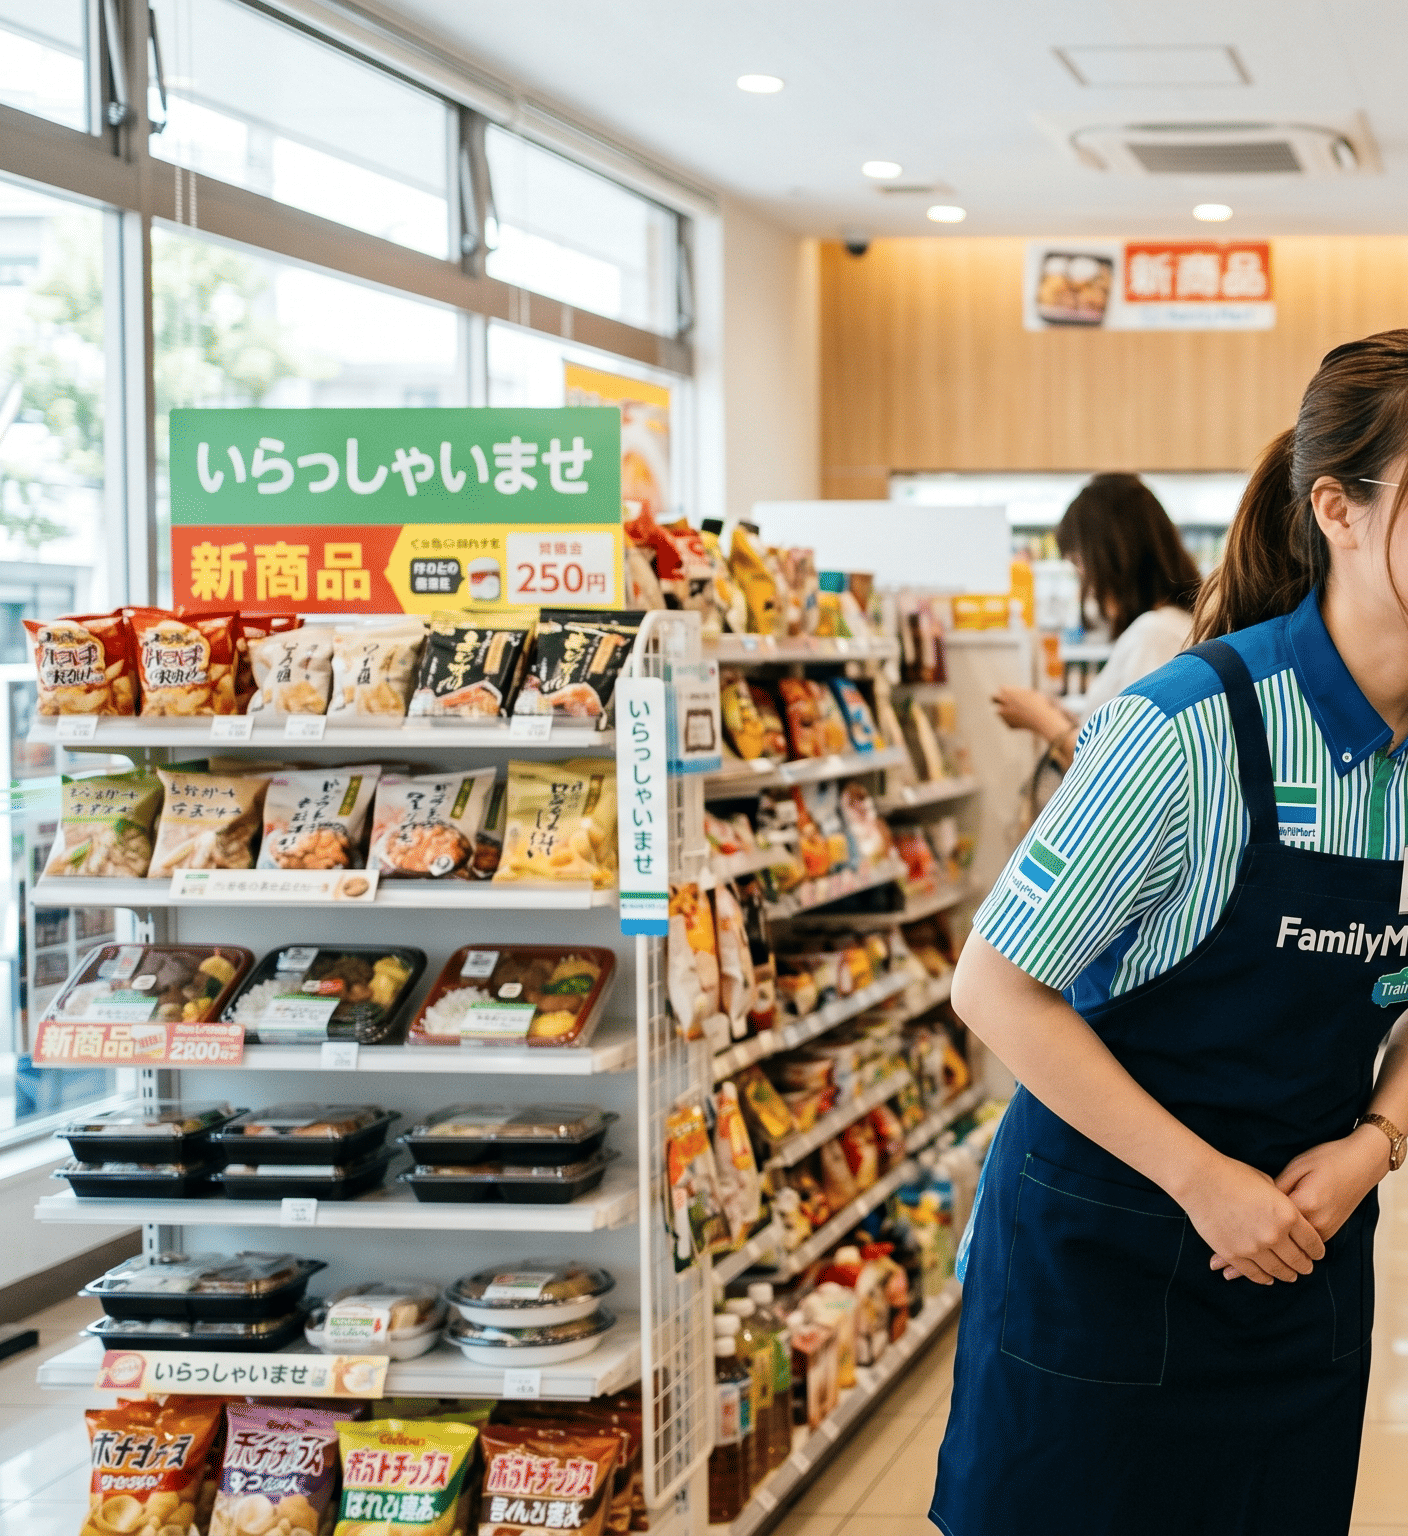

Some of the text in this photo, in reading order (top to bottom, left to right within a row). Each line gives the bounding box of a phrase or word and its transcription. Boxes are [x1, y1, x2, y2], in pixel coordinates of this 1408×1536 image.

[197, 435, 594, 497] いらっしゃいませ
[190, 541, 373, 603] 新商品
[516, 562, 606, 594] 250円
[629, 699, 654, 875] いらっしゃいませ
[41, 1025, 136, 1058] 新商品
[154, 1362, 309, 1386] いらっしゃいませ
